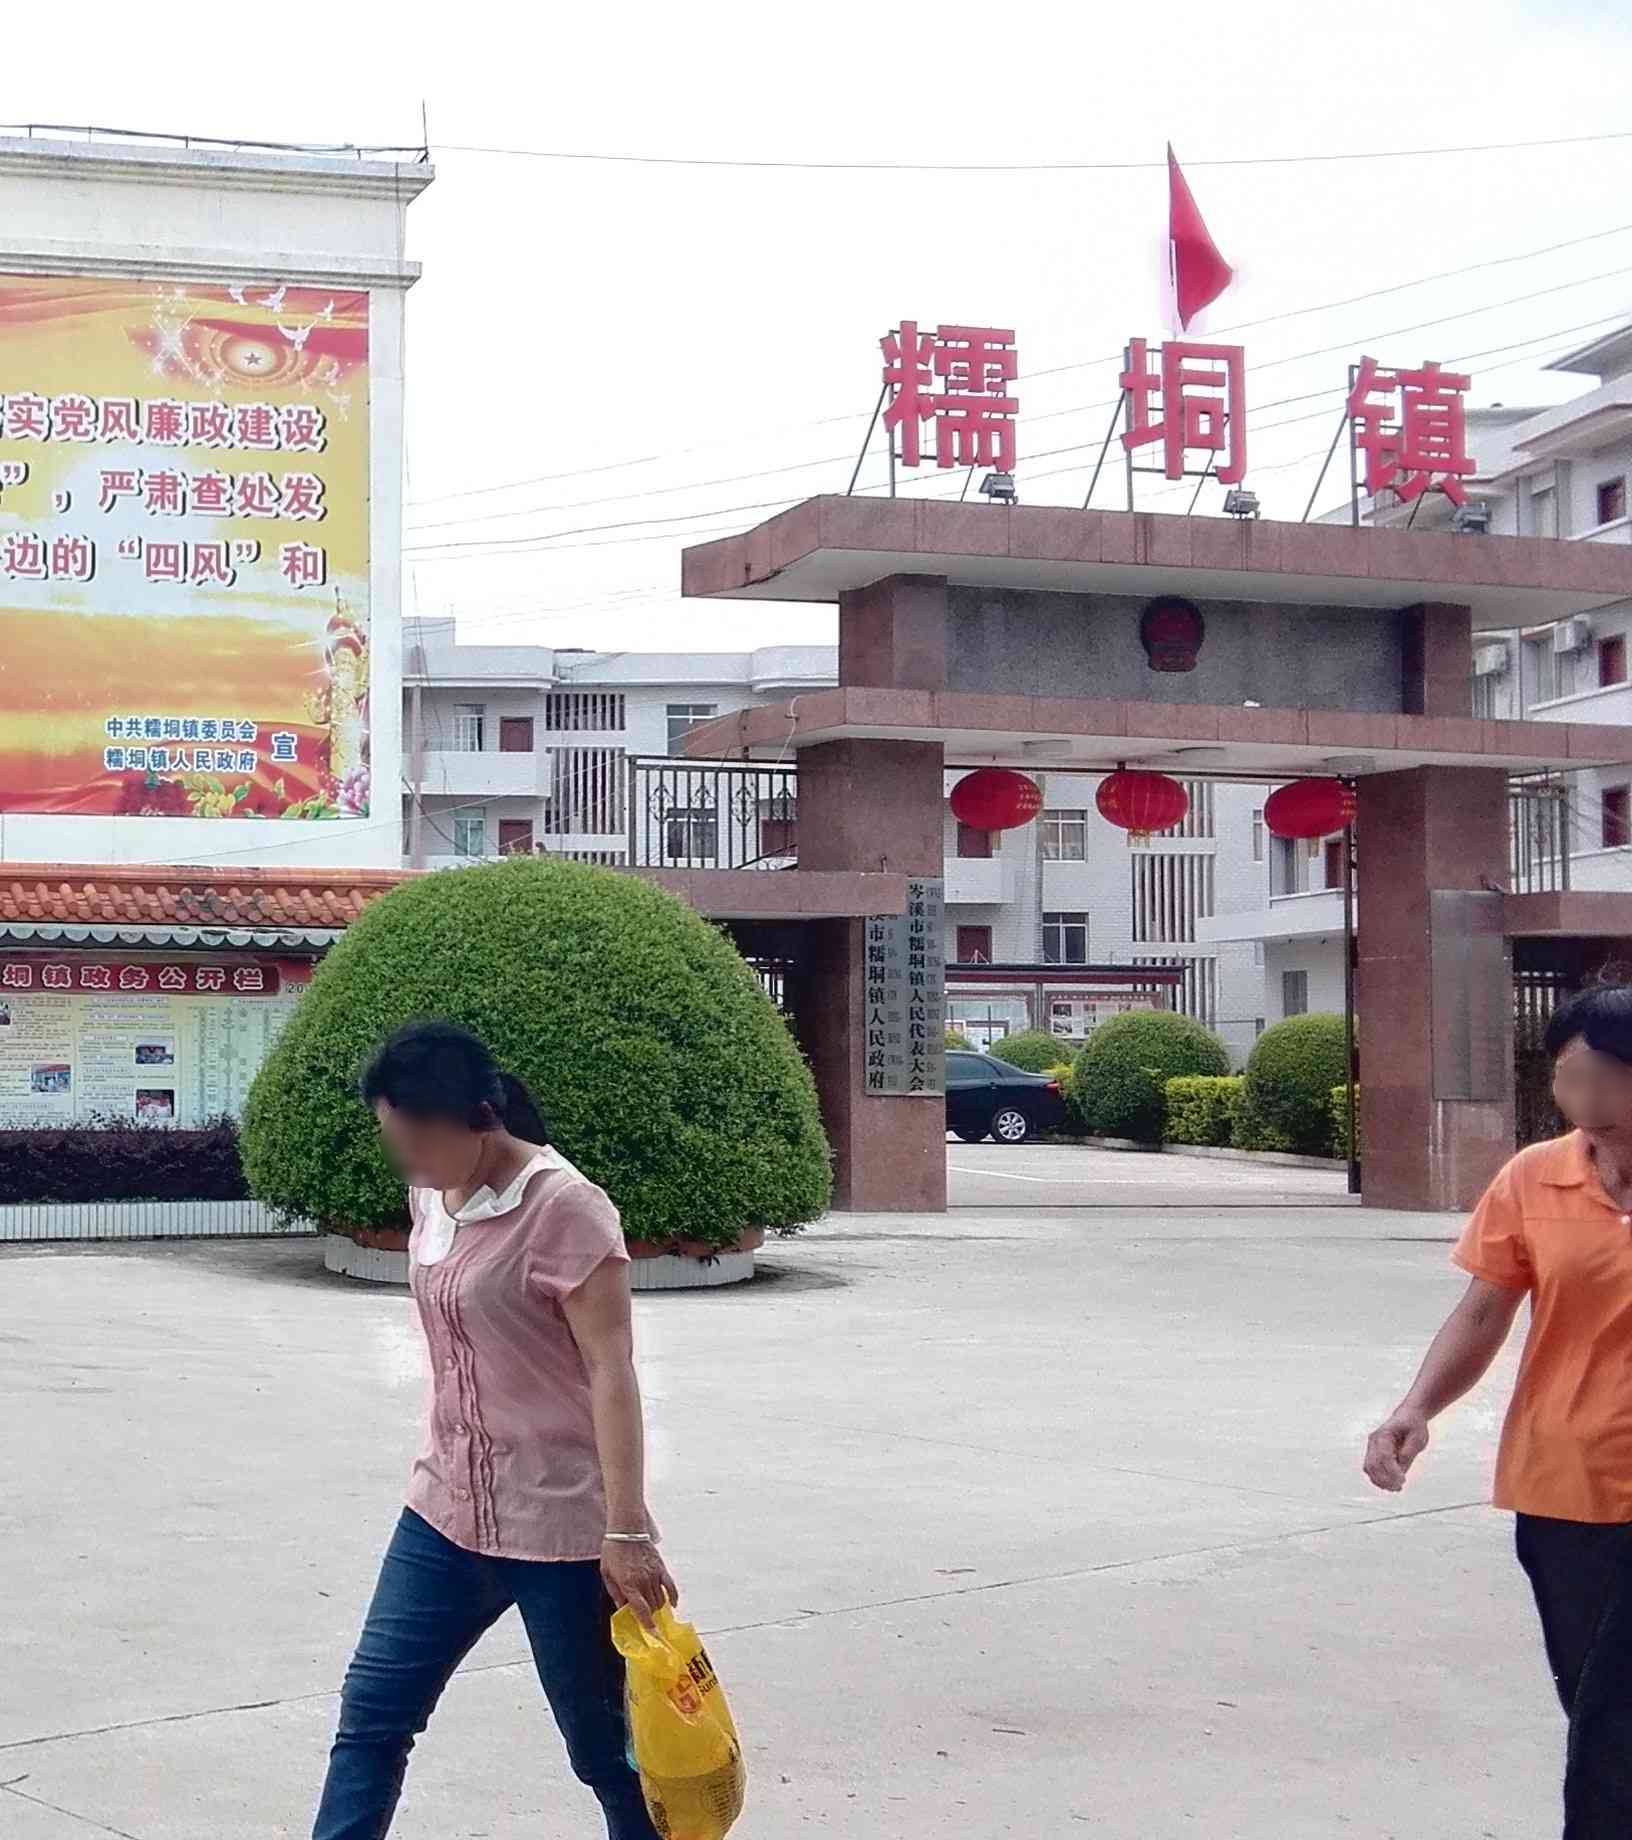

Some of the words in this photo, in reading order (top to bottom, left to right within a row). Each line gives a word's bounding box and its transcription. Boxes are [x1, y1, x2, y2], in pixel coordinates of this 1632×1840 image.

[880, 320, 1477, 508] 糯垌镇
[106, 717, 256, 740] 中共糯垌镇委员会
[106, 748, 255, 771] 糯垌镇人民政府
[273, 733, 296, 760] 宣
[908, 883, 926, 1092] 岑溪市糯垌镇人民代表大会
